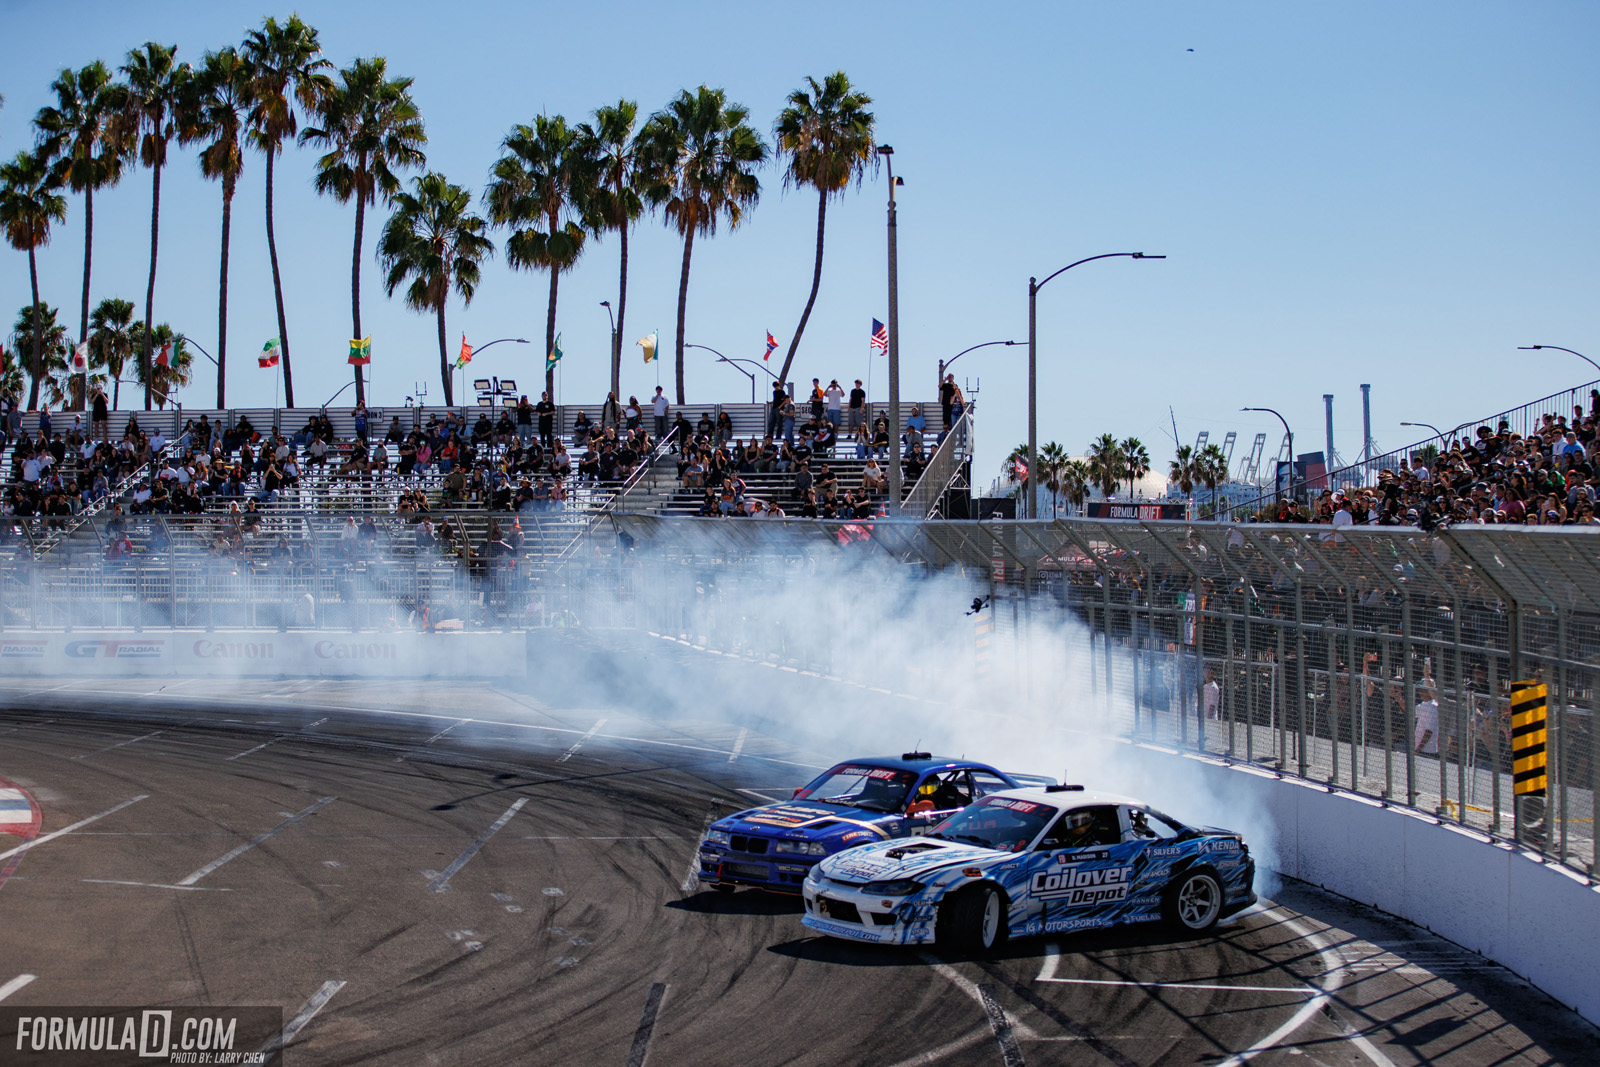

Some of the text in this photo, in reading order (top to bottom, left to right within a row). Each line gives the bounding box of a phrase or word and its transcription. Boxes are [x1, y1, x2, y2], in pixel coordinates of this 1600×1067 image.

[1110, 506, 1160, 519] FORMULA DRIFT
[64, 640, 119, 658] GT
[193, 640, 274, 658] Canon
[314, 640, 397, 659] Canon
[869, 769, 896, 780] DRIFT
[1010, 801, 1037, 812] DRIFT
[1153, 845, 1181, 856] SILVER'S
[1212, 840, 1240, 850] KENDA
[1031, 866, 1132, 892] Coilover
[1071, 886, 1126, 906] Depot
